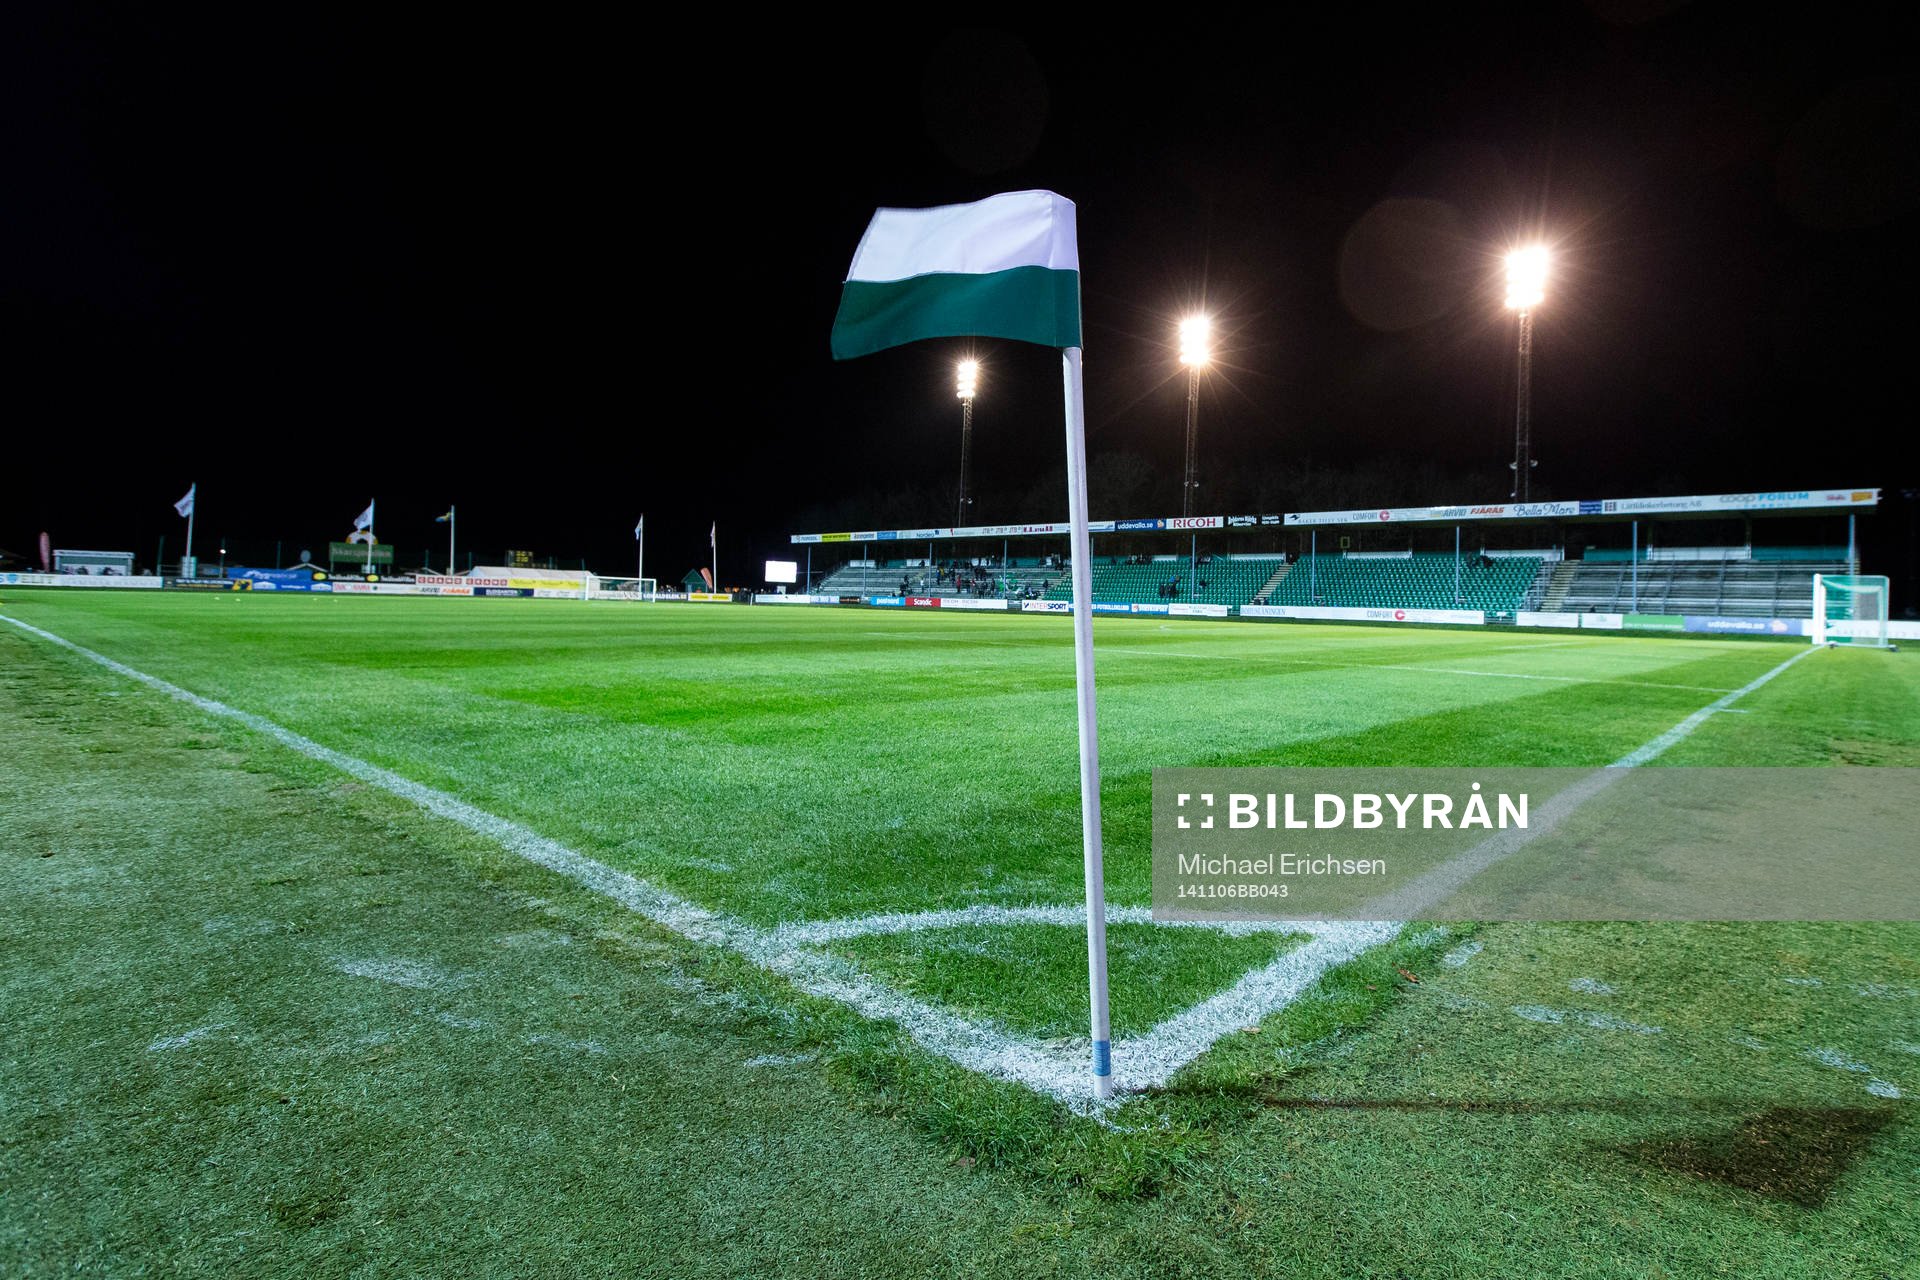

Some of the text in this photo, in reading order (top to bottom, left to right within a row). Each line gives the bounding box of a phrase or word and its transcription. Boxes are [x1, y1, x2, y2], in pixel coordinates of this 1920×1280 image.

[1759, 492, 1808, 501] FORUM
[1352, 511, 1378, 521] COMFORT
[1117, 522, 1153, 530] uddevalla.se
[1173, 517, 1216, 529] RICOH
[913, 598, 933, 606] Scandic
[1030, 602, 1067, 611] INTERSPORT
[1707, 620, 1765, 630] uddevalla.se
